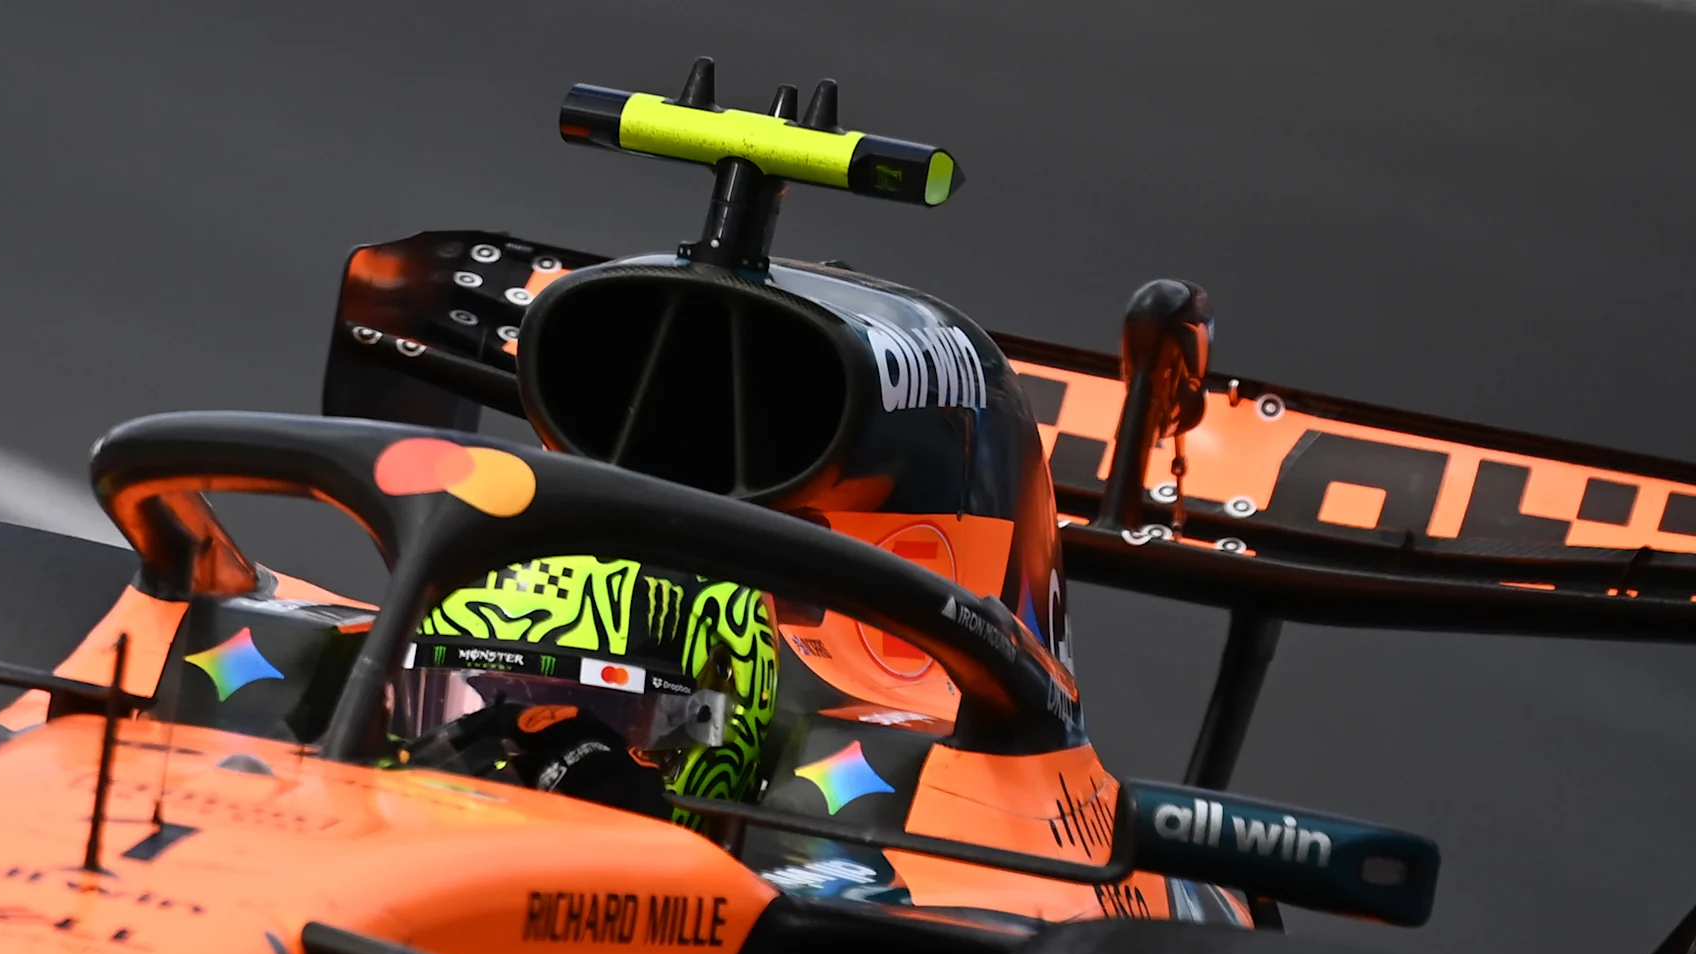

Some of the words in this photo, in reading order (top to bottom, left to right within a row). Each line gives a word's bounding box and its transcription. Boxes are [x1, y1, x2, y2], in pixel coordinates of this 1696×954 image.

[958, 605, 985, 635] IRON
[458, 649, 525, 665] MONSTER
[663, 680, 692, 694] Dropbox
[1155, 799, 1224, 847] all
[1232, 816, 1332, 867] win
[523, 892, 639, 944] RICHARD
[643, 895, 728, 946] MILLE
